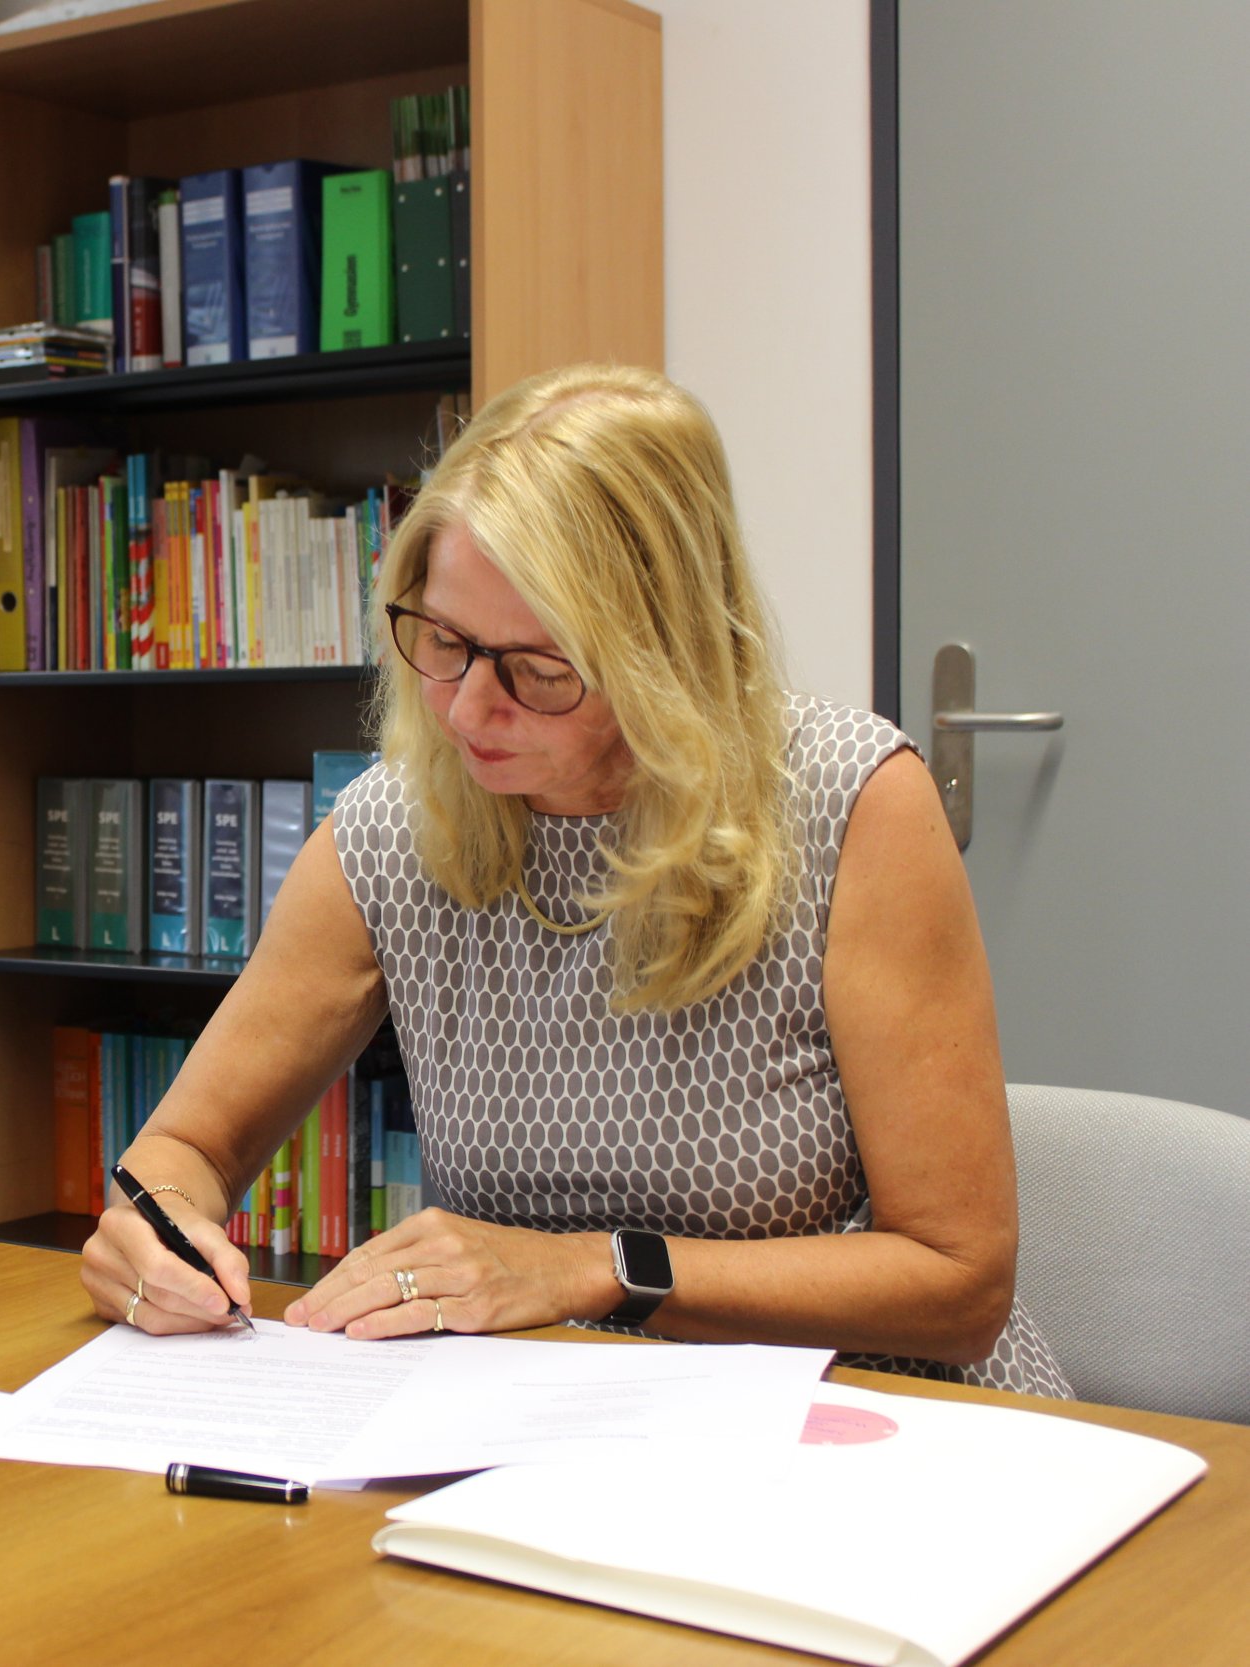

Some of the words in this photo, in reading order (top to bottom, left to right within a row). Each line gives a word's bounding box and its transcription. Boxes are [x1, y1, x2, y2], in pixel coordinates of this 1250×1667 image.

[47, 810, 68, 823] SPE
[98, 811, 120, 824] SPE
[157, 811, 178, 825] SPE
[215, 813, 238, 827] SPE
[52, 927, 60, 941] L
[104, 929, 113, 945] L
[220, 935, 230, 952] L
